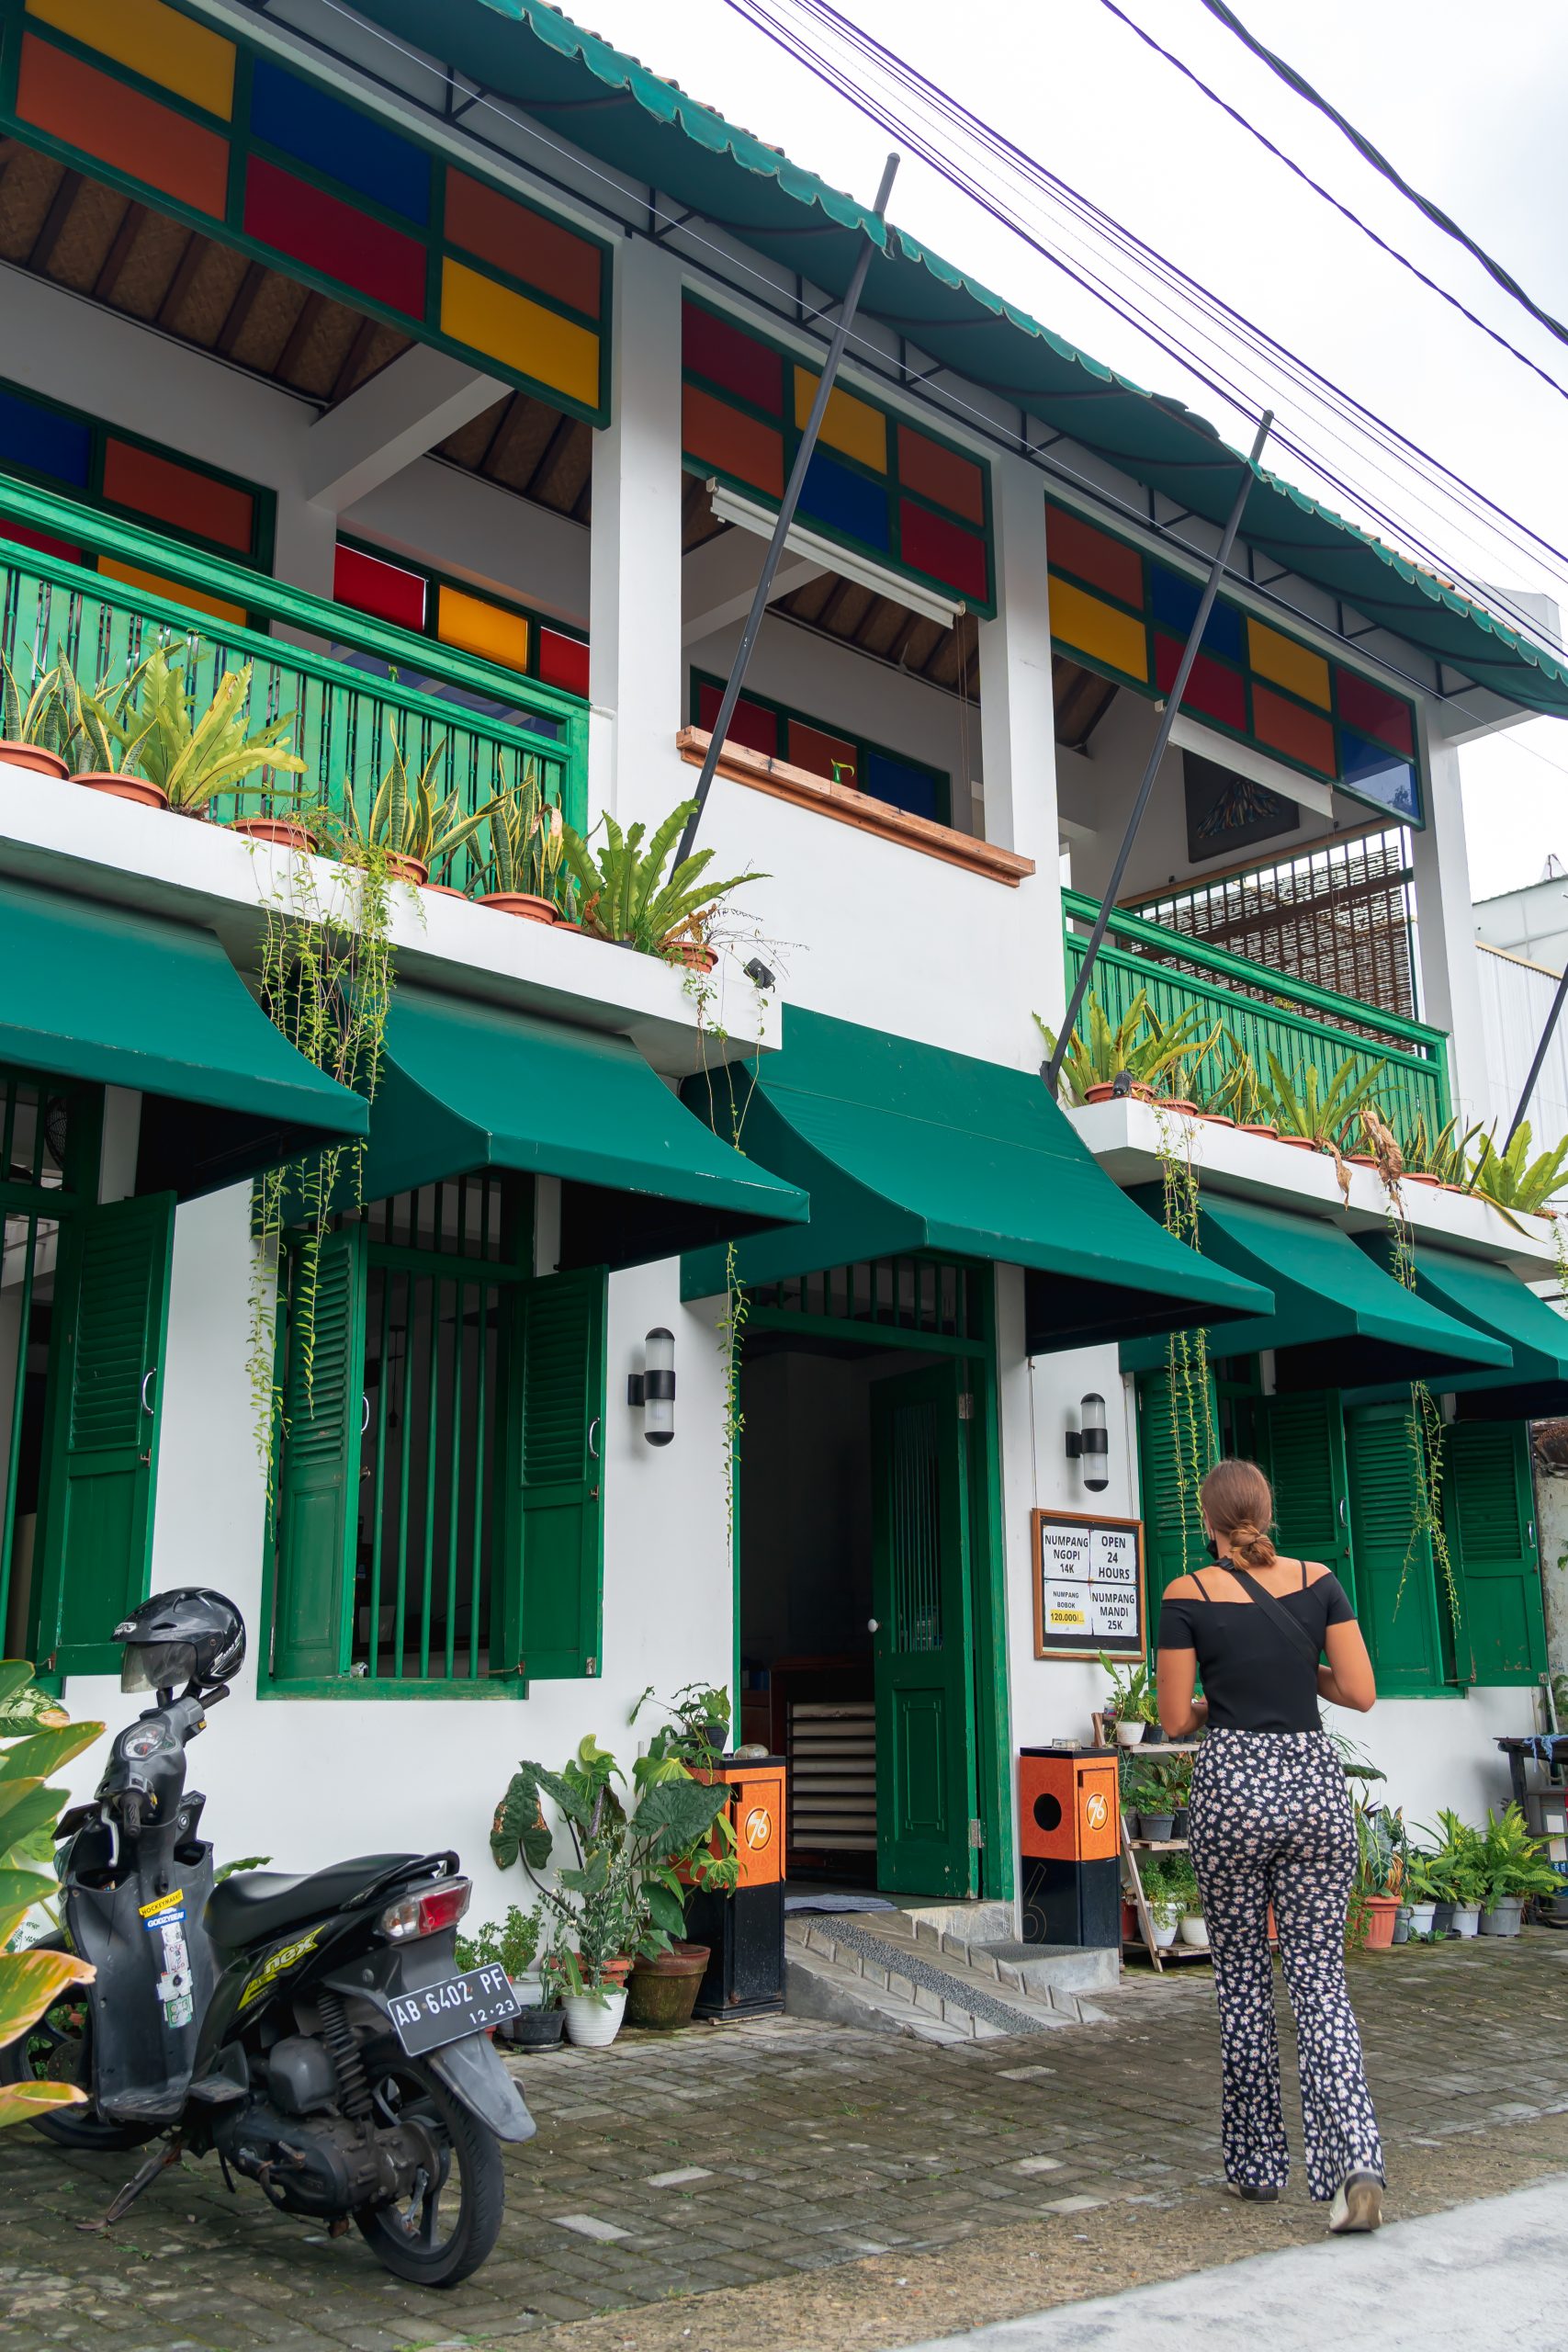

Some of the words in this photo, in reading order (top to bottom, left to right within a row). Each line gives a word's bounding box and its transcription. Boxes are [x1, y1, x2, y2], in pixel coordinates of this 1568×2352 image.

[1045, 1534, 1089, 1548] NUMPANG
[1101, 1535, 1126, 1549] OPEN
[1054, 1549, 1080, 1561] NGOPI
[1107, 1552, 1119, 1564] 24
[1060, 1563, 1075, 1574] 14K
[1099, 1566, 1130, 1580] HOURS
[1053, 1590, 1079, 1600] NUMPANG
[1092, 1592, 1135, 1604] NUMPANG
[1100, 1606, 1129, 1617] MANDI
[1108, 1620, 1123, 1631] 25K
[395, 2000, 422, 2026] AB
[425, 1981, 473, 2015] 6402
[479, 1968, 503, 1994] PF
